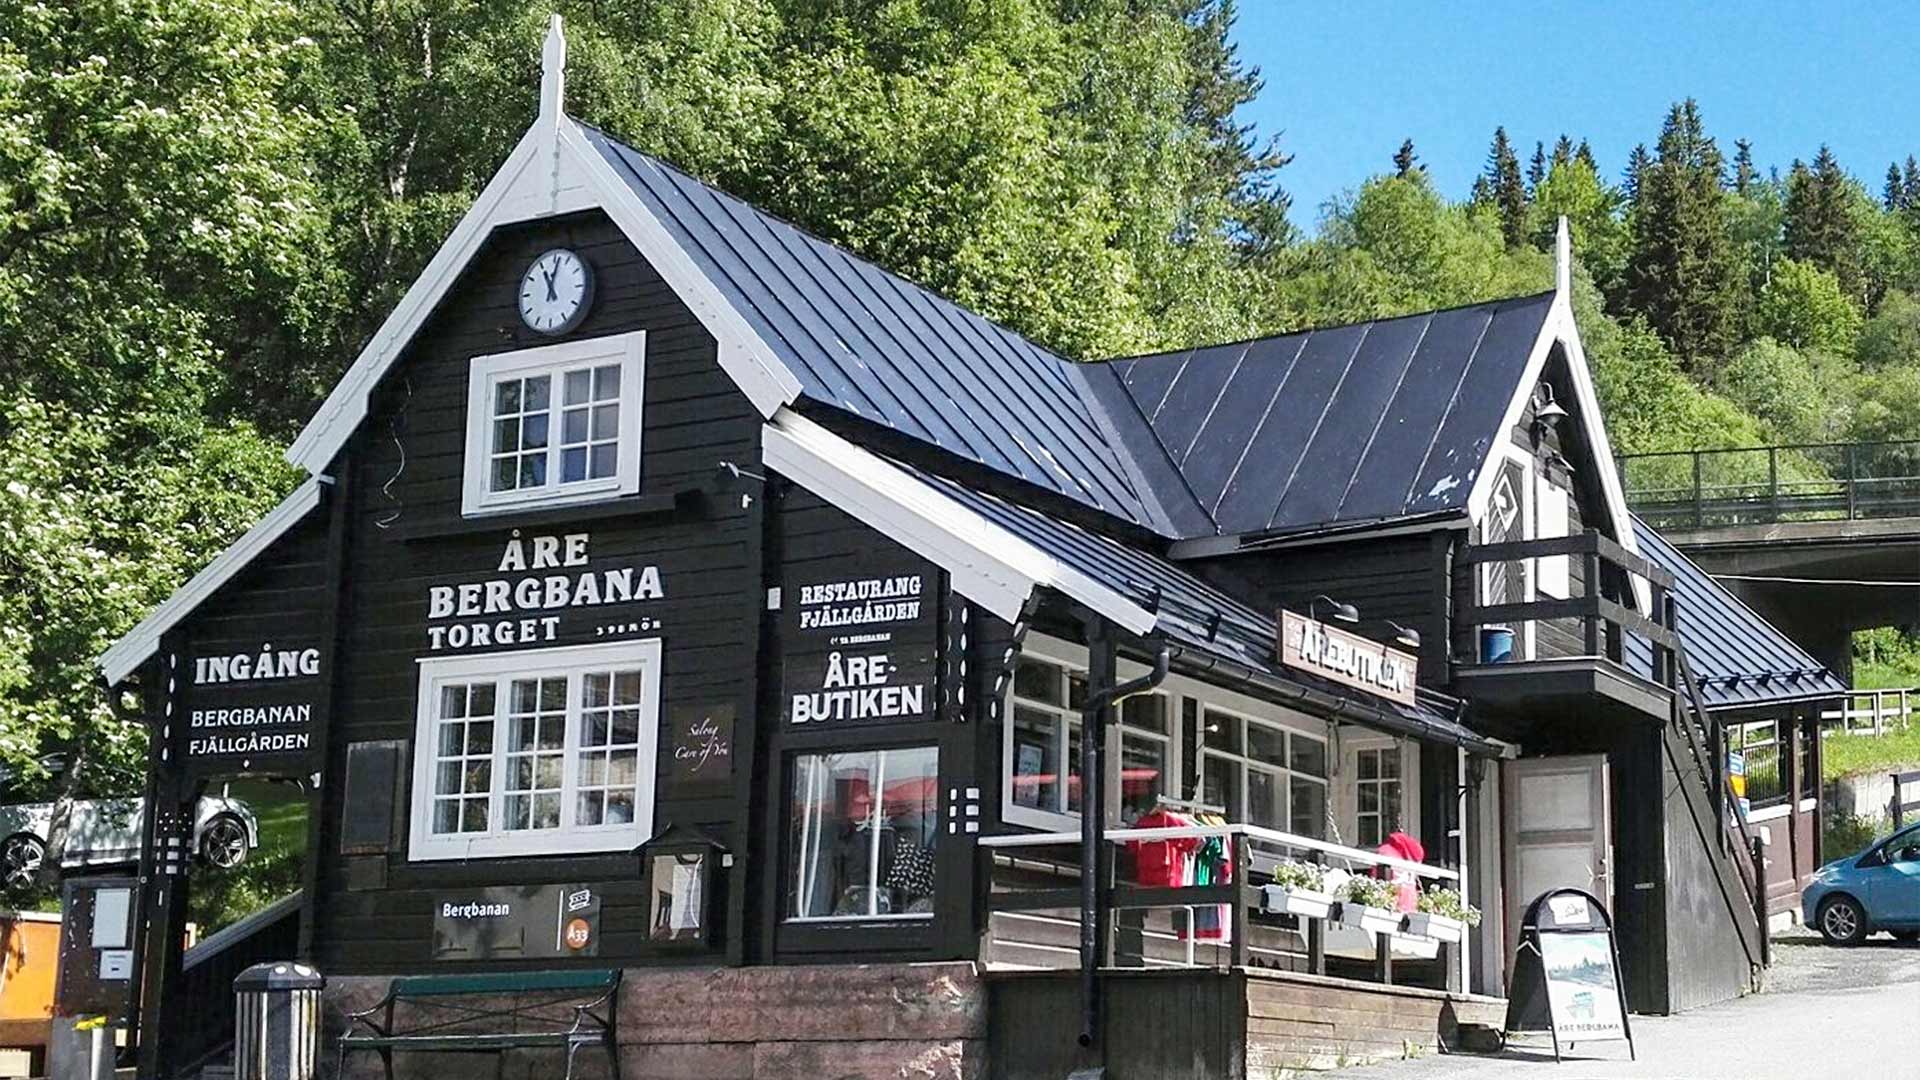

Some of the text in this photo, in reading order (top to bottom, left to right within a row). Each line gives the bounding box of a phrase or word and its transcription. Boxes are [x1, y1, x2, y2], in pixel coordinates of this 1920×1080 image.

[498, 529, 589, 571] ÅRE
[428, 566, 664, 619] BERGBANA
[800, 576, 921, 605] RESTAURANG
[800, 600, 920, 629] FJÄLLGÅRDEN
[428, 617, 560, 650] TORGET
[194, 643, 320, 684] INGÅNG
[823, 651, 897, 688] ÅRE-
[190, 704, 311, 727] BERGBANAN
[791, 684, 923, 723] BUTIKEN
[189, 731, 309, 755] FJÄLLGÅRDEN
[442, 902, 510, 919] Bergbanan
